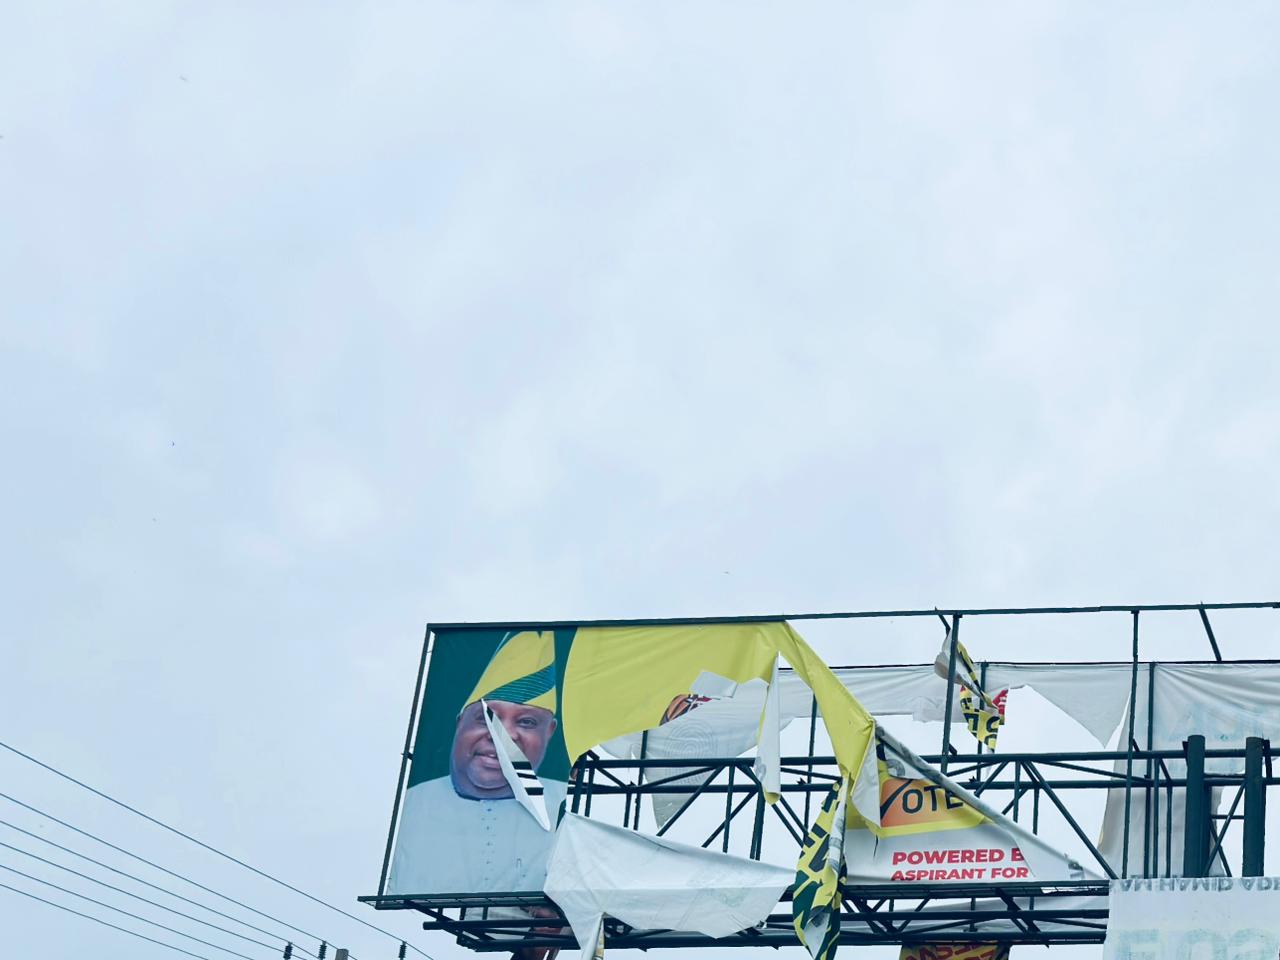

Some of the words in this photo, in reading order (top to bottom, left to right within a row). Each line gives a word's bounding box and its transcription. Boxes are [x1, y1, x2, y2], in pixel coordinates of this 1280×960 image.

[892, 848, 1005, 865] POWERED
[891, 868, 987, 881] ASPIRANT
[991, 867, 1029, 879] FOR
